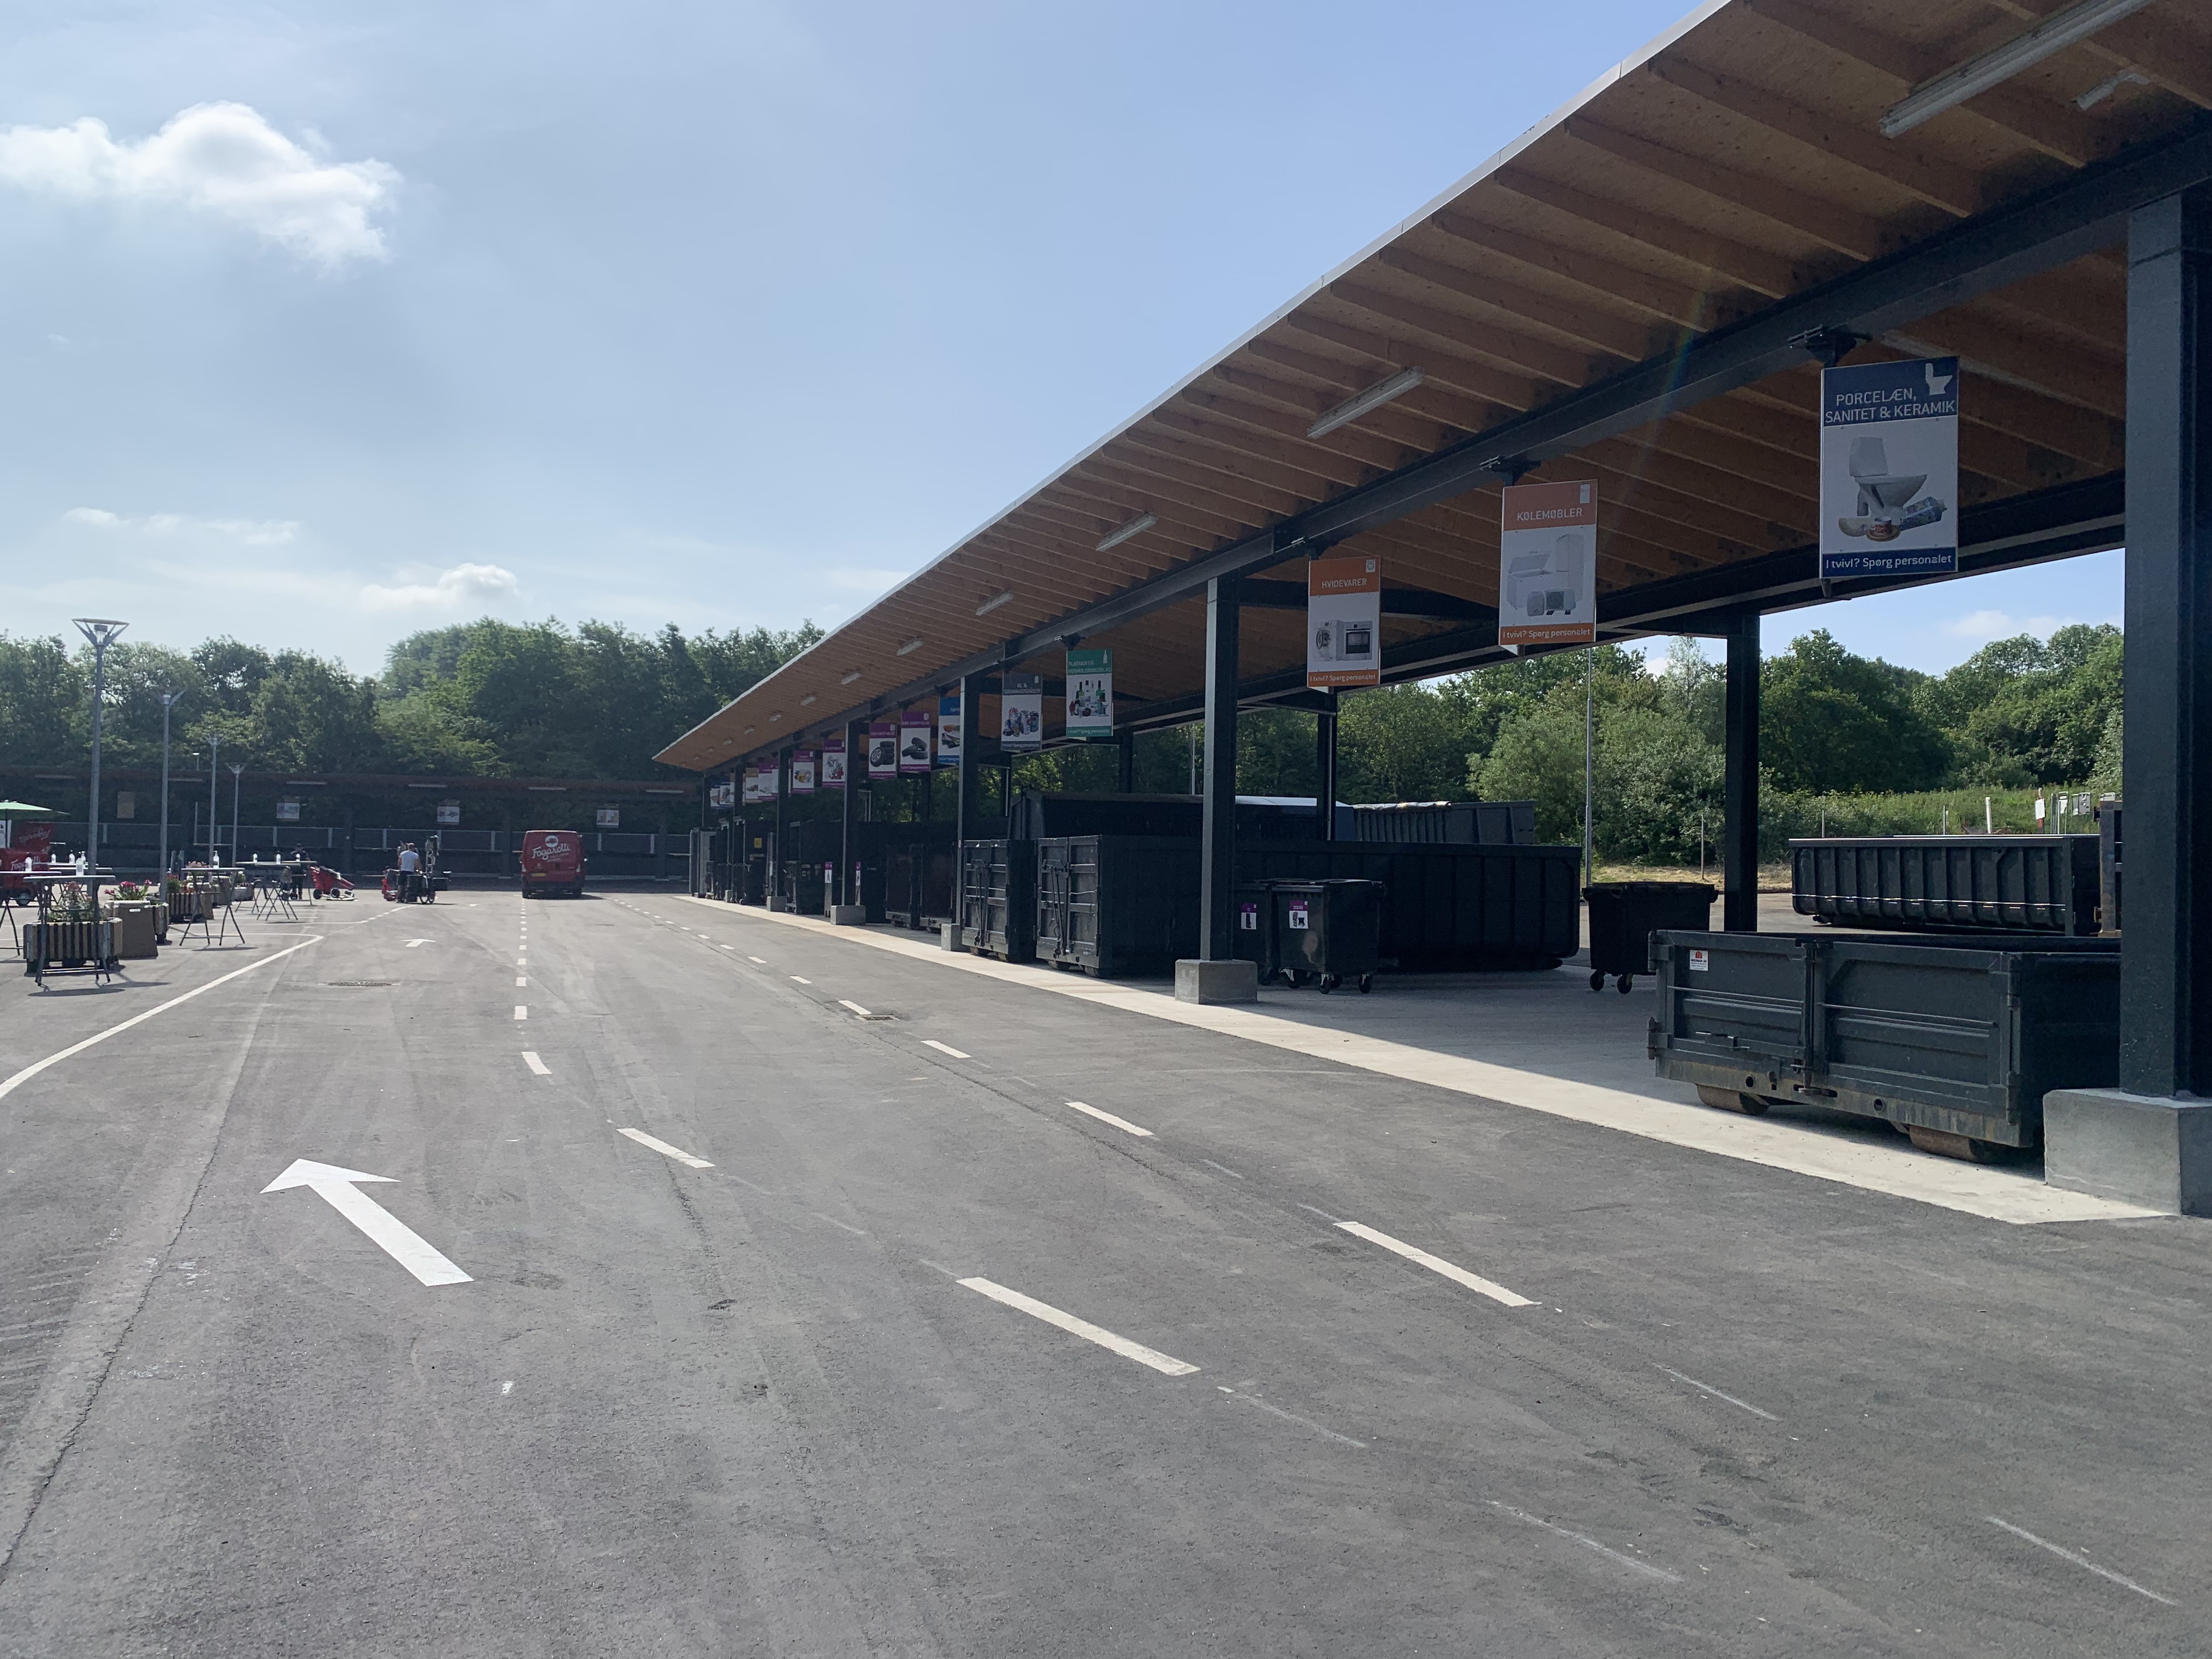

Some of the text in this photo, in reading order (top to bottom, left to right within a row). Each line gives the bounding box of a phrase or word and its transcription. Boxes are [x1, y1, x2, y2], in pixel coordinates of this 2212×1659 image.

[1836, 387, 1917, 407] PORCELÆN,
[1825, 399, 1955, 424] SANITET & KERAMIK
[1517, 507, 1583, 522] KØLEMØBLER
[1826, 554, 1953, 569] I tvivl? Spørg personalet
[1322, 578, 1367, 589] HVIDEVARER
[1506, 630, 1527, 639] tvivl?
[1528, 630, 1549, 639] Spørg
[1551, 628, 1591, 639] personalet
